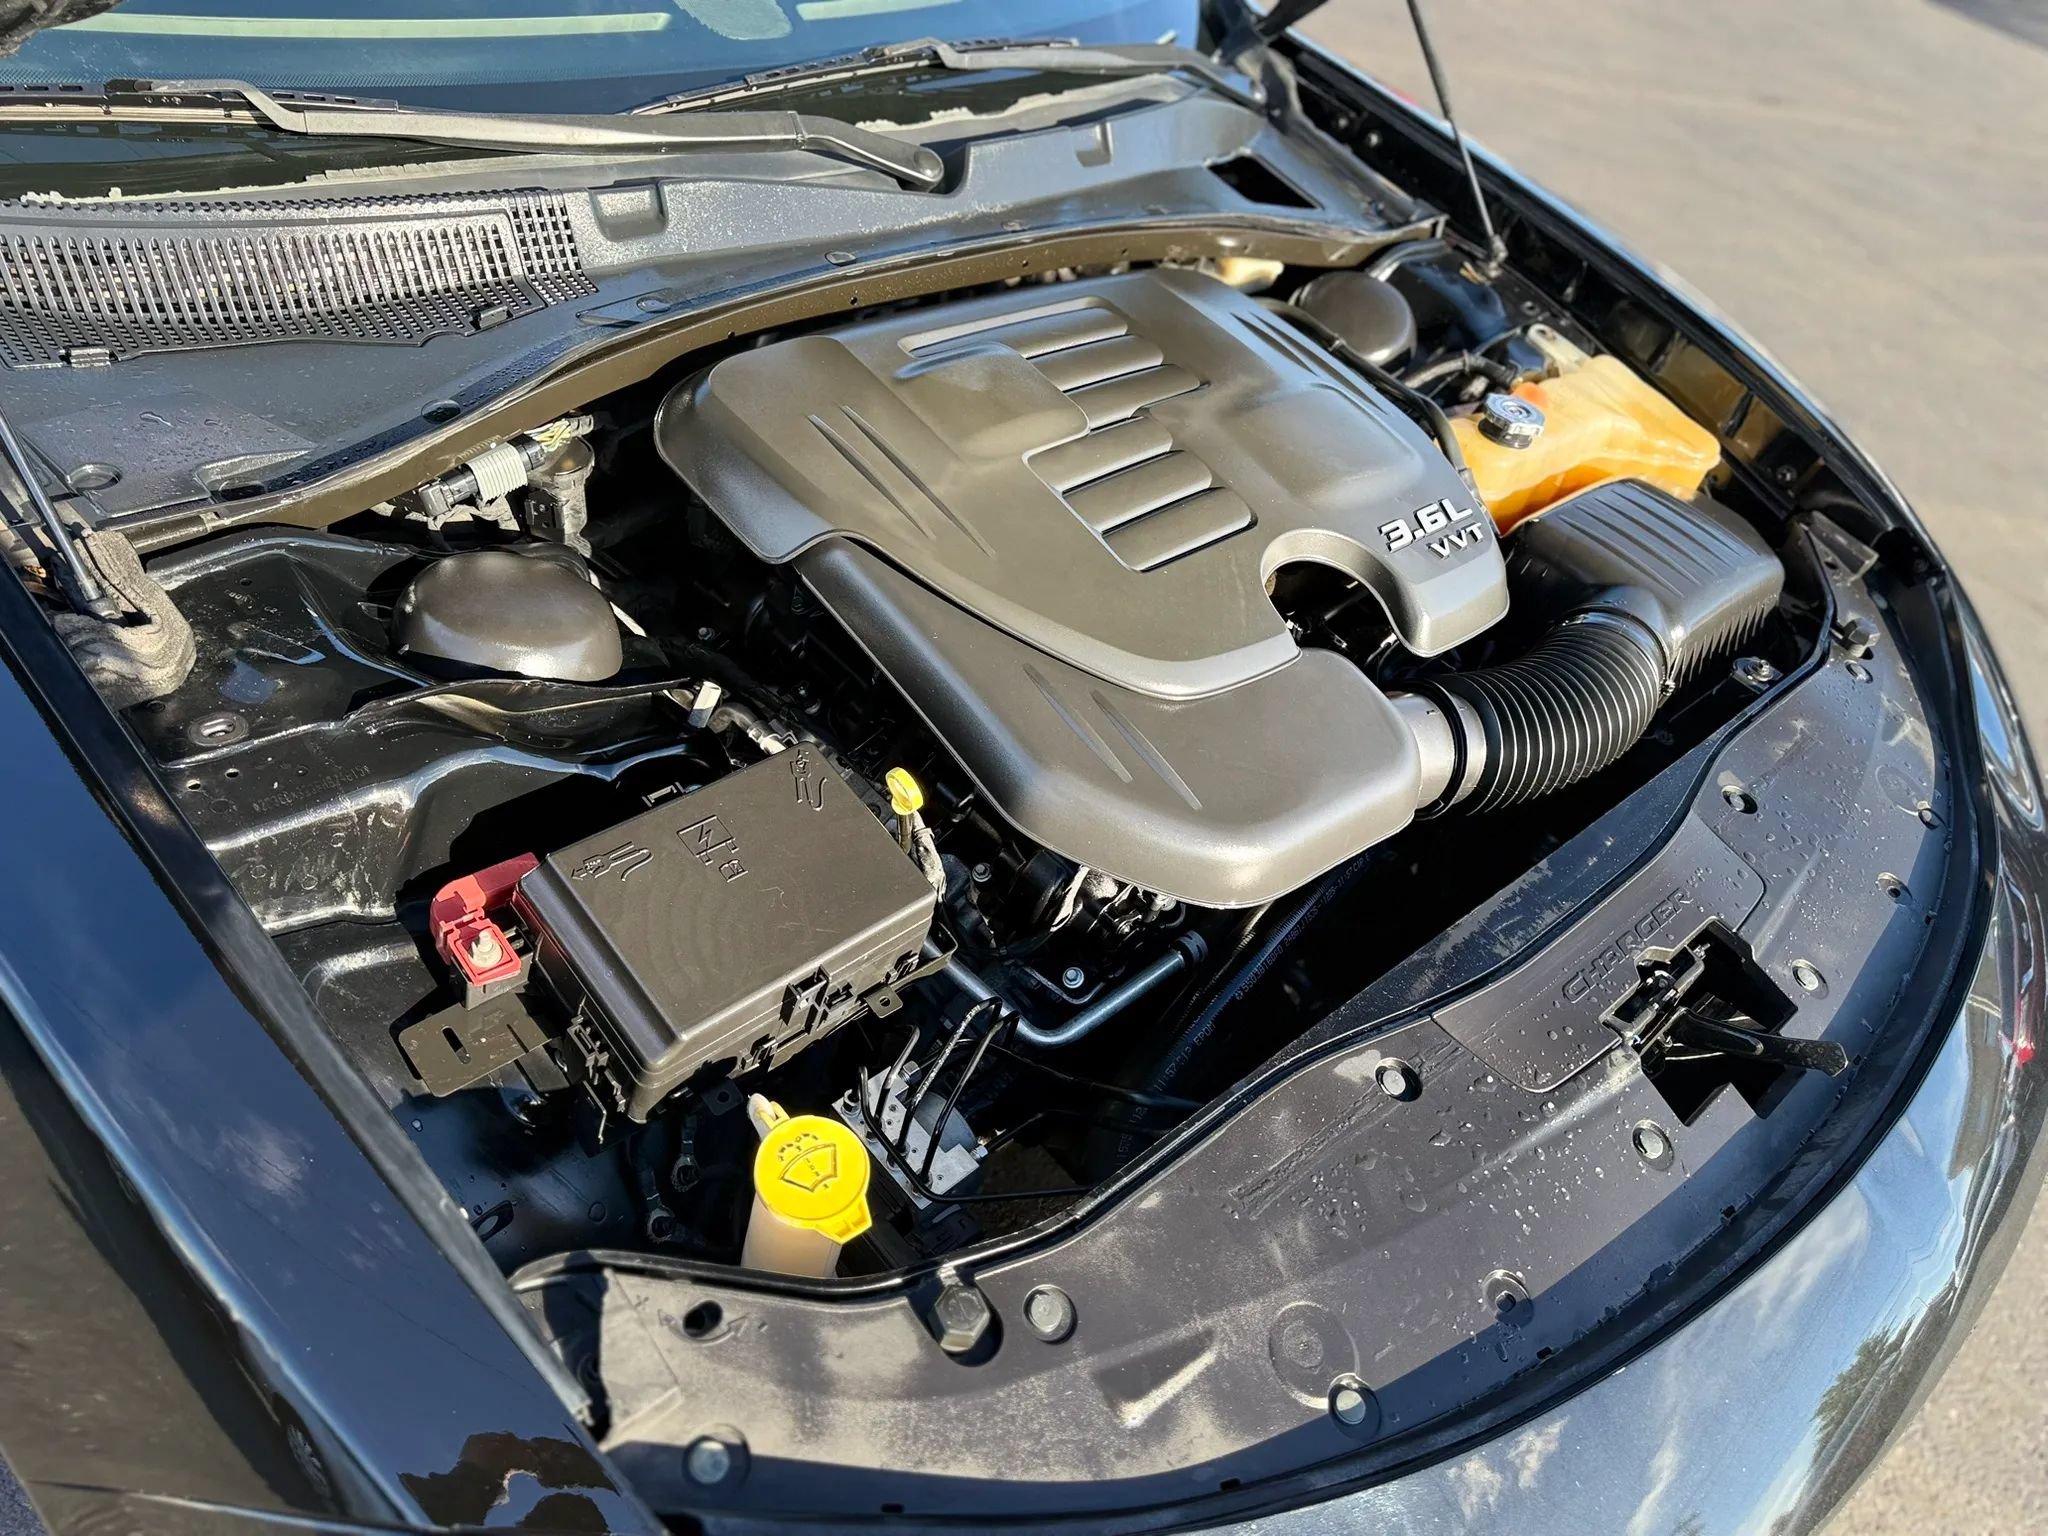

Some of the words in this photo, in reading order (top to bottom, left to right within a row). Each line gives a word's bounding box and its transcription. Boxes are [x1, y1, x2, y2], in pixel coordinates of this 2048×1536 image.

[1378, 499, 1473, 553] 3.6L
[1427, 523, 1484, 560] VVT
[1562, 888, 1694, 1004] CHARGER
